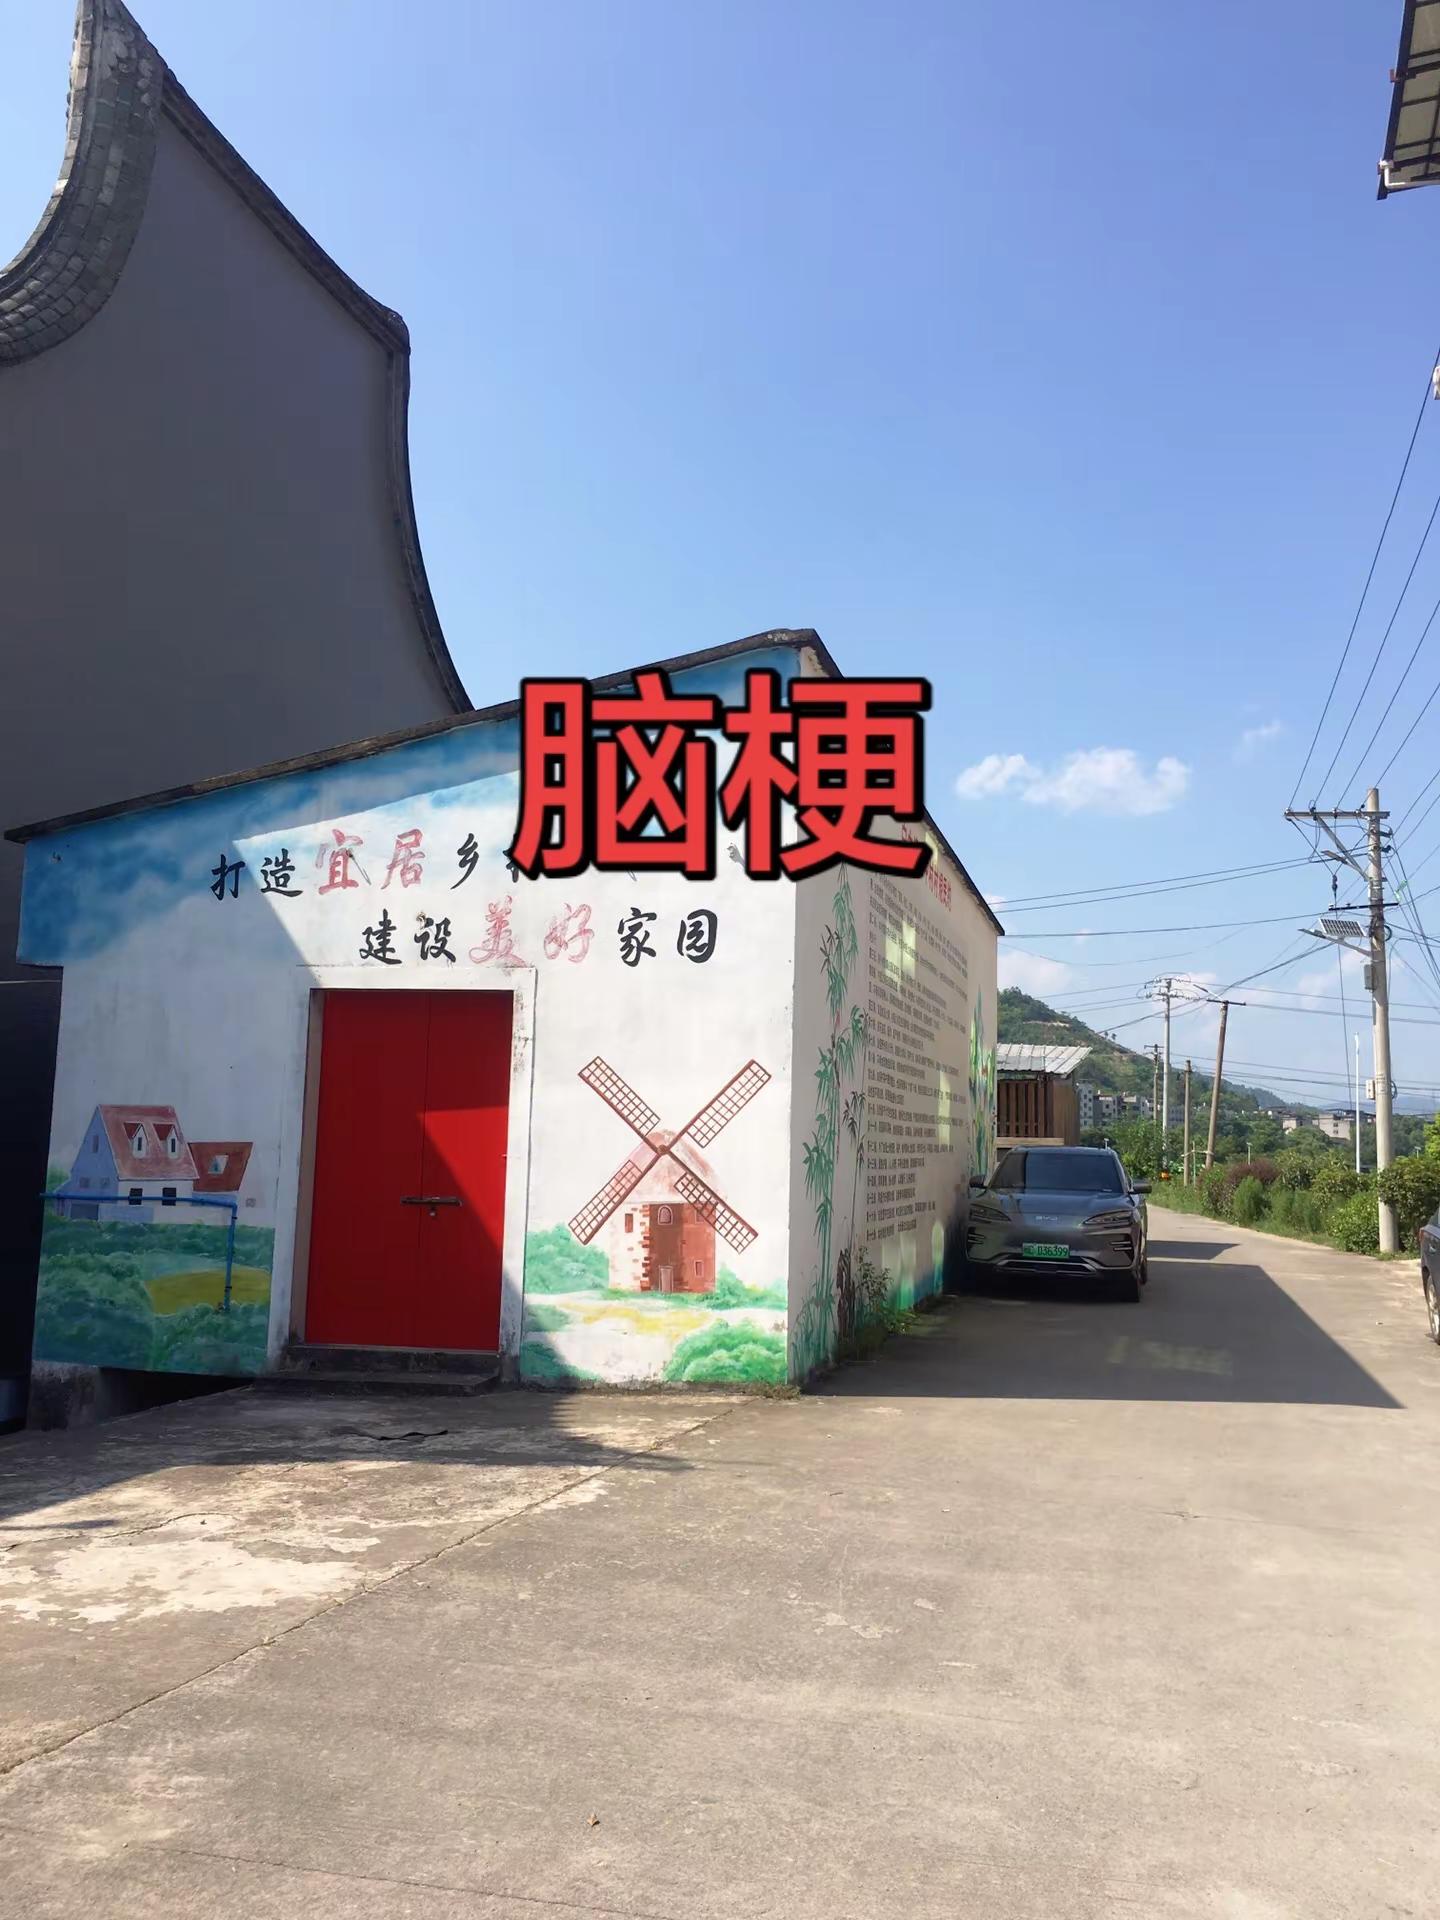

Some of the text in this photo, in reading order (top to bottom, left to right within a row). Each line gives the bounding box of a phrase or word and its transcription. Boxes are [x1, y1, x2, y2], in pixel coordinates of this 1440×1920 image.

[359, 896, 718, 967] 建设美好家园
